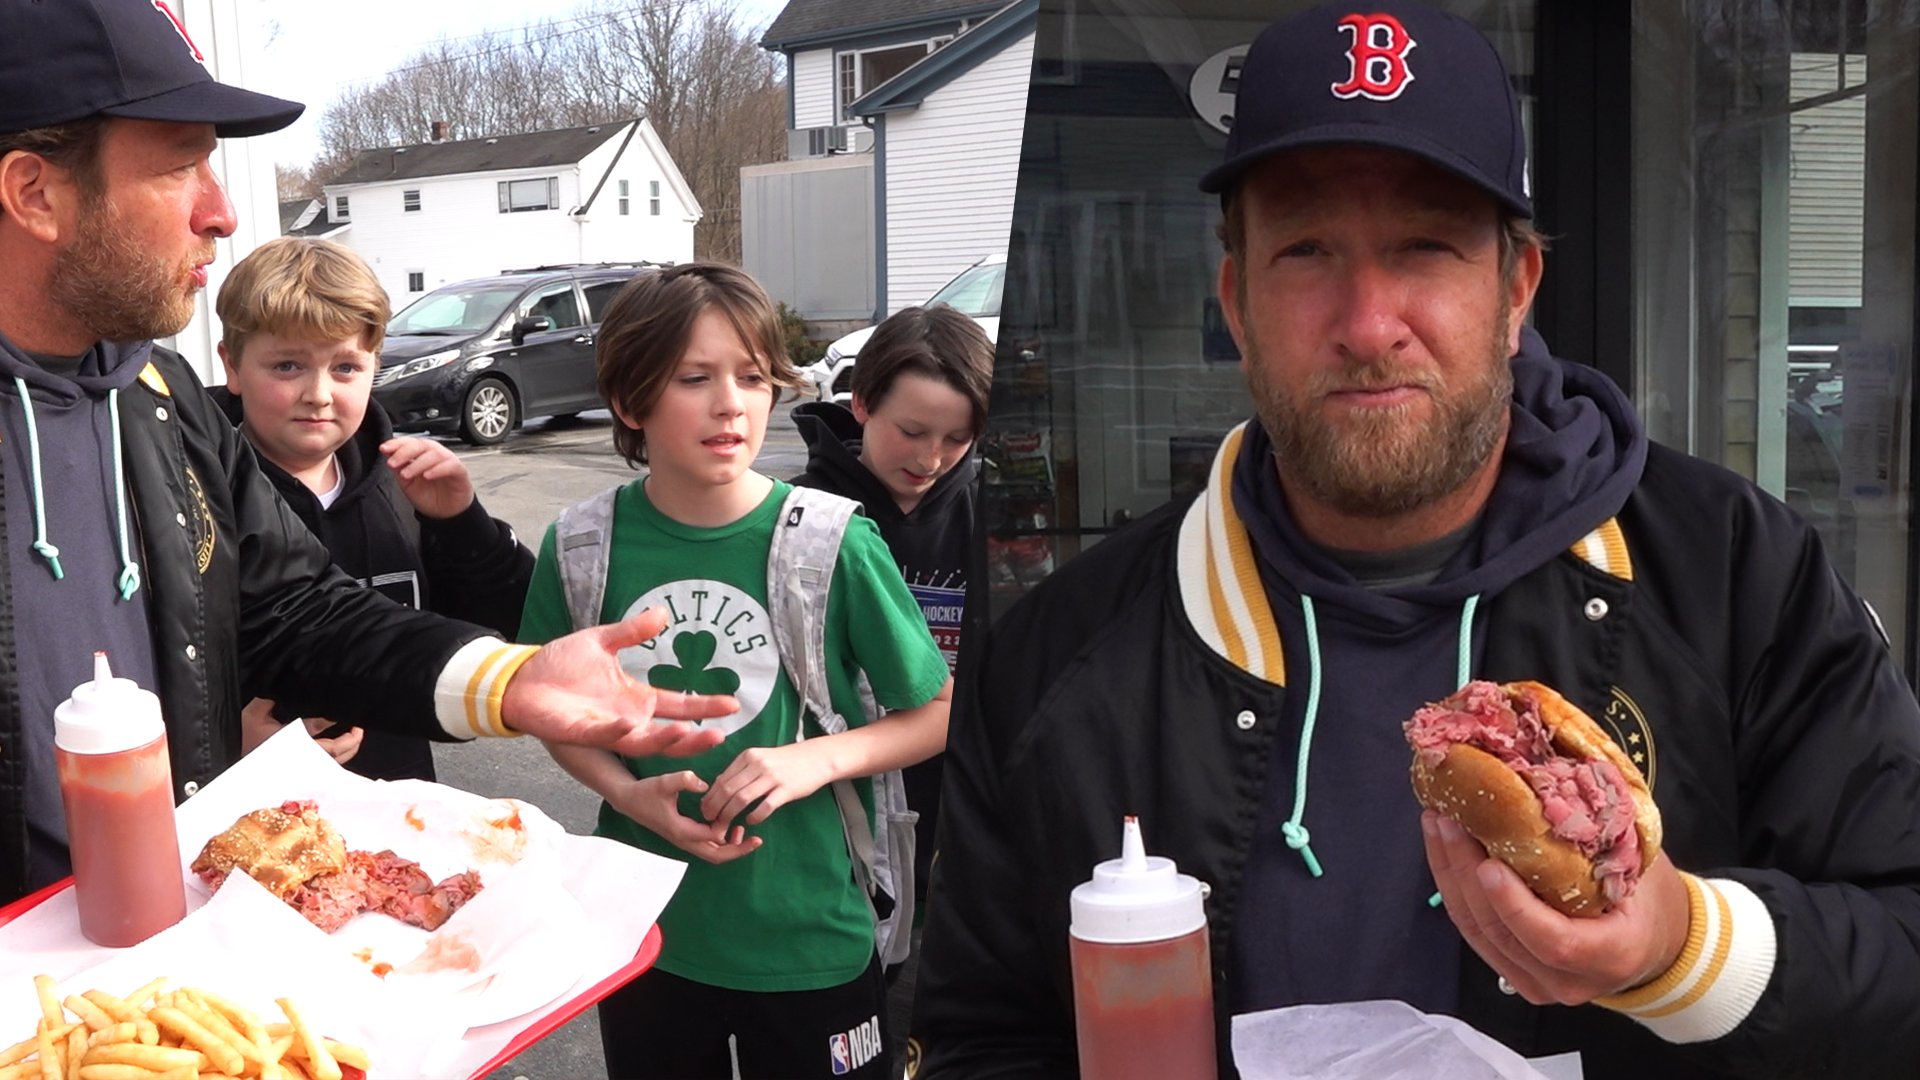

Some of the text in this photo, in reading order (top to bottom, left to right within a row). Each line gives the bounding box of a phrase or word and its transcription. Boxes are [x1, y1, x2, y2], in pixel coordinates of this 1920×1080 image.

[1331, 12, 1418, 101] B
[639, 590, 768, 654] LTICS
[923, 606, 964, 623] HOCKEY
[848, 1015, 882, 1070] NBA
